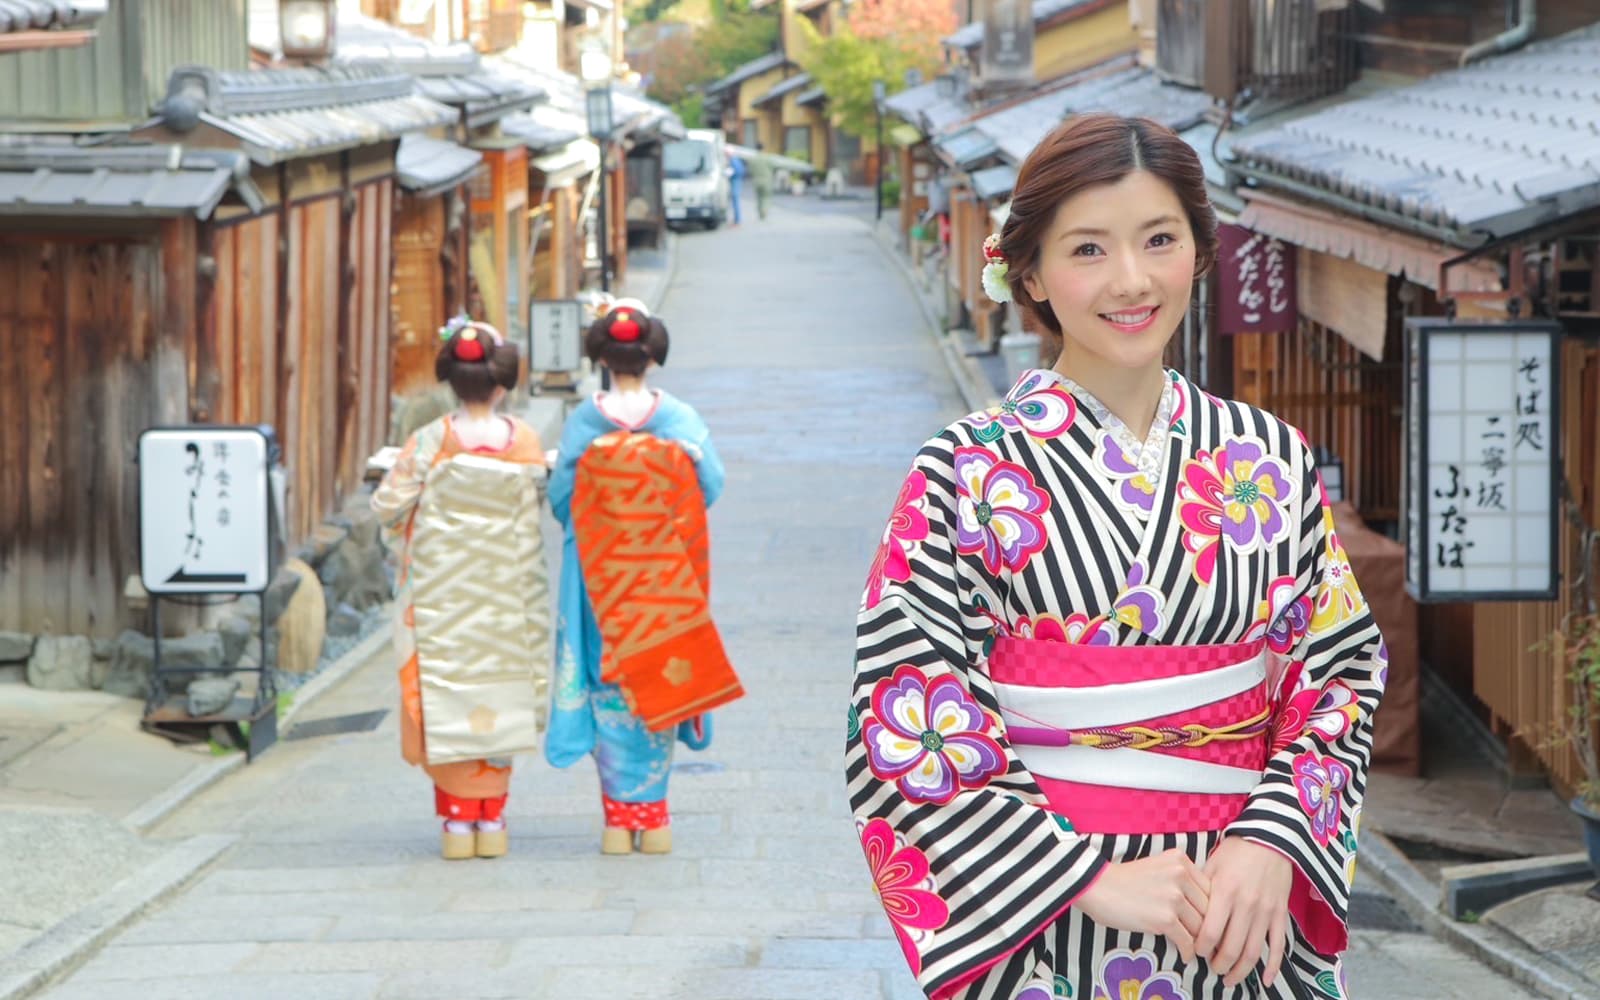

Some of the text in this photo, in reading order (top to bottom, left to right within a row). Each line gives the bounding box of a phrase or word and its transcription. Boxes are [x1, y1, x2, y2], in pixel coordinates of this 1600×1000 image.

[1515, 356, 1544, 452] そば処
[1434, 464, 1476, 569] ふたば
